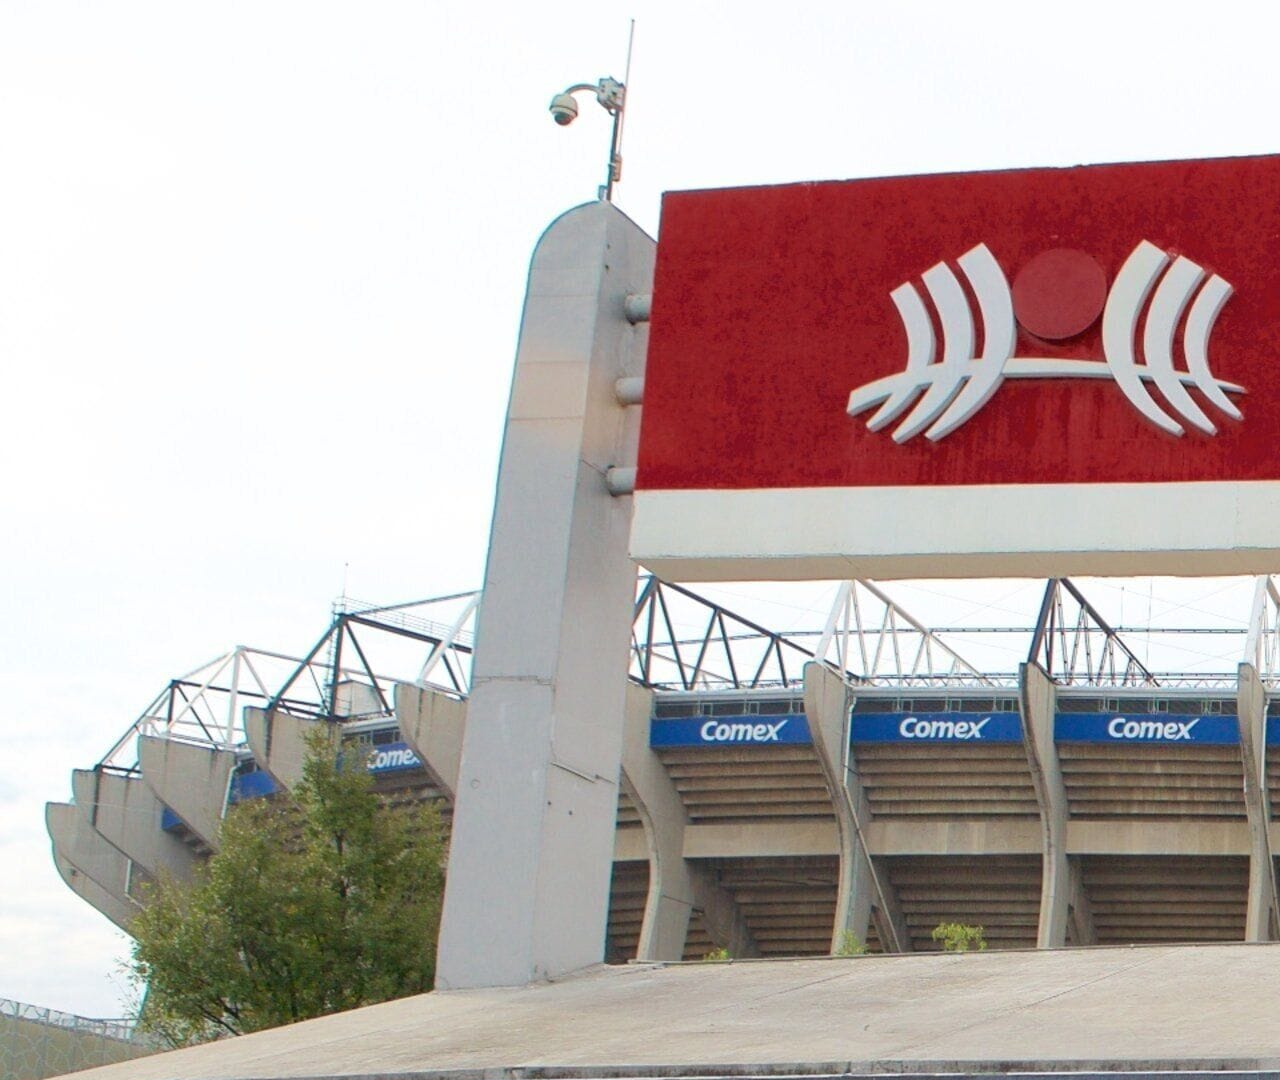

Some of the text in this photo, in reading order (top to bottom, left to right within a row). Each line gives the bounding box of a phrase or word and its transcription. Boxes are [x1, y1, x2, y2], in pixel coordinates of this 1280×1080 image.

[701, 719, 788, 742] Comex
[900, 717, 990, 740] Comex
[1108, 717, 1199, 740] Comex
